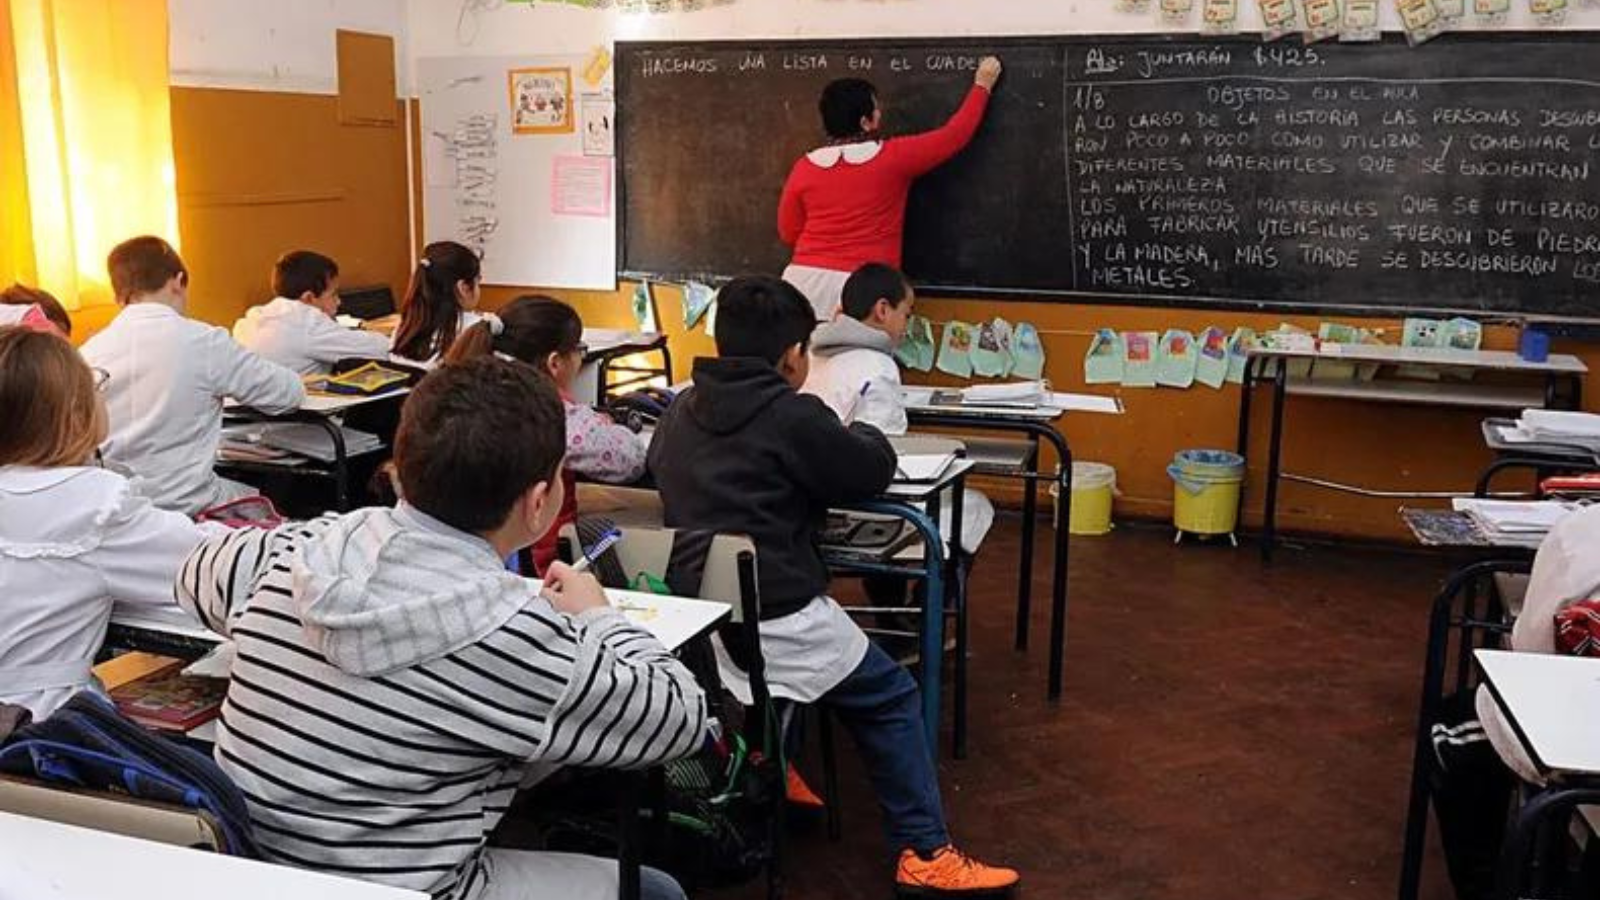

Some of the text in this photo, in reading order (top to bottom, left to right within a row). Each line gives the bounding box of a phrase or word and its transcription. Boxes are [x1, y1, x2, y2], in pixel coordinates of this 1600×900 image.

[642, 57, 718, 78] HACEMOS
[739, 54, 767, 71] UNA
[848, 56, 872, 70] EN
[891, 57, 912, 71] EL
[1137, 45, 1230, 77] JUNTARÁN
[1073, 83, 1104, 110] 1/8
[1207, 86, 1290, 110] OBJETOS
[1312, 86, 1337, 99] EN
[1350, 87, 1371, 99] EL
[1075, 116, 1086, 133] A
[1096, 114, 1115, 129] LO
[1128, 112, 1184, 128] CARGO
[1197, 112, 1219, 126] DE
[1237, 112, 1259, 125] LA
[1382, 109, 1417, 125] LAS
[1433, 108, 1521, 127] PERSONAS
[1540, 107, 1600, 127] DESCUB
[1075, 136, 1107, 152] RON
[1126, 132, 1169, 148] POCO
[1180, 132, 1191, 146] A
[1204, 131, 1248, 147] POCO
[1341, 131, 1421, 149] UTILIZAR
[1469, 134, 1570, 151] COMBINAR
[1589, 134, 1600, 149] L
[1076, 154, 1589, 181] DIFERENTES MATERIALES QUE SE ENCUENTRAN
[1079, 175, 1226, 194] LA NATURALEZA
[1080, 198, 1117, 216] LOS
[1257, 197, 1378, 217] MATERIALES
[1402, 195, 1439, 214] QUE
[1453, 196, 1479, 215] SE
[1080, 214, 1127, 239] PARA
[1147, 215, 1241, 235] FABRICAR
[1387, 224, 1471, 246] FUERON
[1487, 228, 1515, 246] DE
[1079, 242, 1090, 268] Y
[1105, 243, 1126, 261] LA
[1134, 243, 1219, 272] MADERA,
[1299, 242, 1360, 267] TARDE
[1380, 251, 1409, 268] SE
[1420, 250, 1557, 276] DESCUBRIERON
